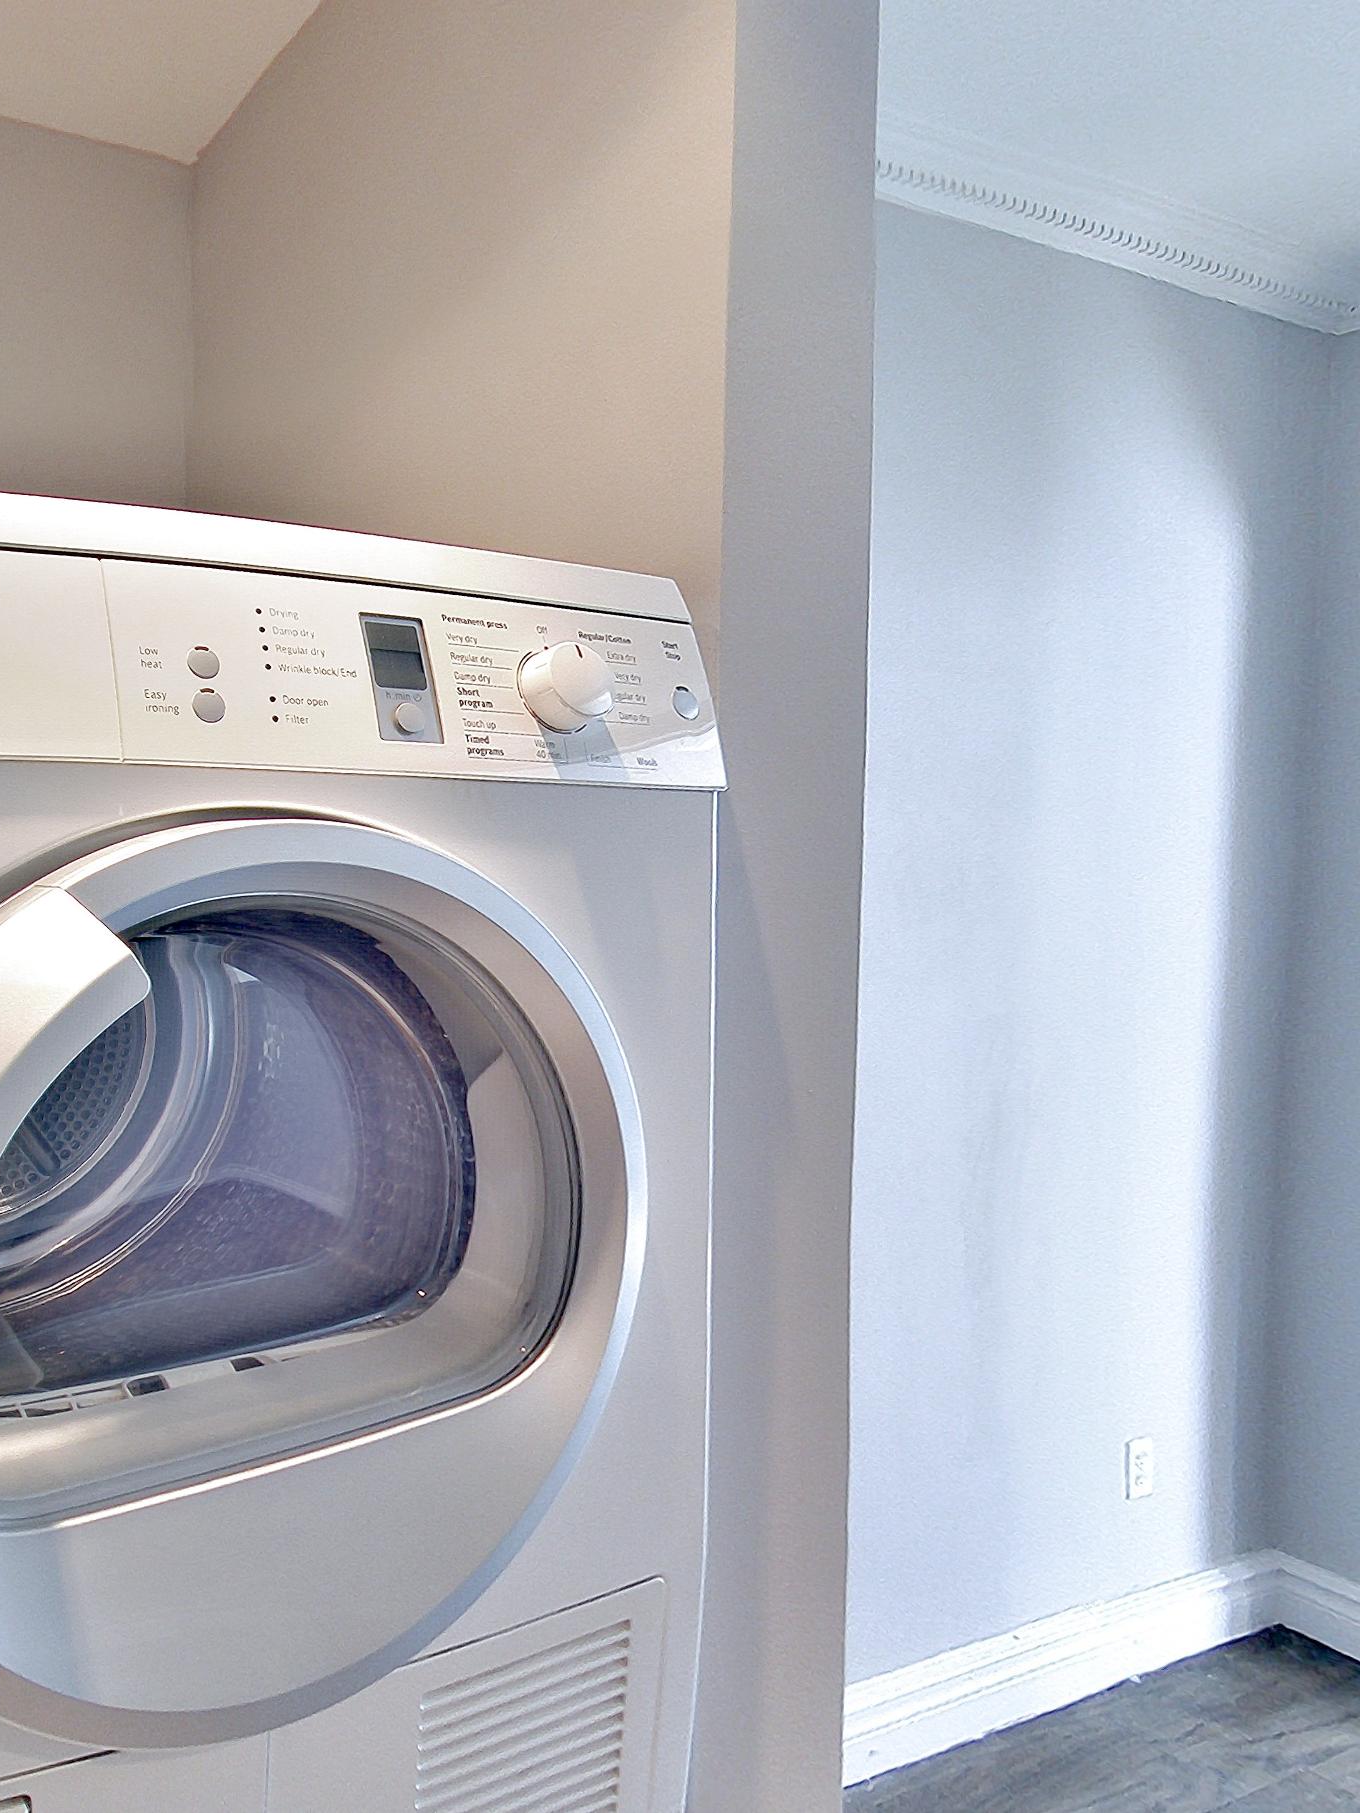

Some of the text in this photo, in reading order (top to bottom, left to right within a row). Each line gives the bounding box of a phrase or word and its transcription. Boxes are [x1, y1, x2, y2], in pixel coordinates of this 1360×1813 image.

[269, 607, 299, 621] Drying
[138, 646, 159, 656] Low
[275, 643, 326, 658] Regular dry
[141, 659, 162, 669] heat
[480, 655, 494, 666] dry
[278, 663, 312, 675] Wrinkle
[478, 673, 491, 684] dry
[144, 689, 167, 701] Easy
[283, 694, 329, 708] Door open
[145, 703, 179, 716] ironing
[458, 698, 493, 709] program
[285, 713, 310, 724] Filter
[462, 717, 497, 731] Touch up
[467, 745, 505, 757] programs
